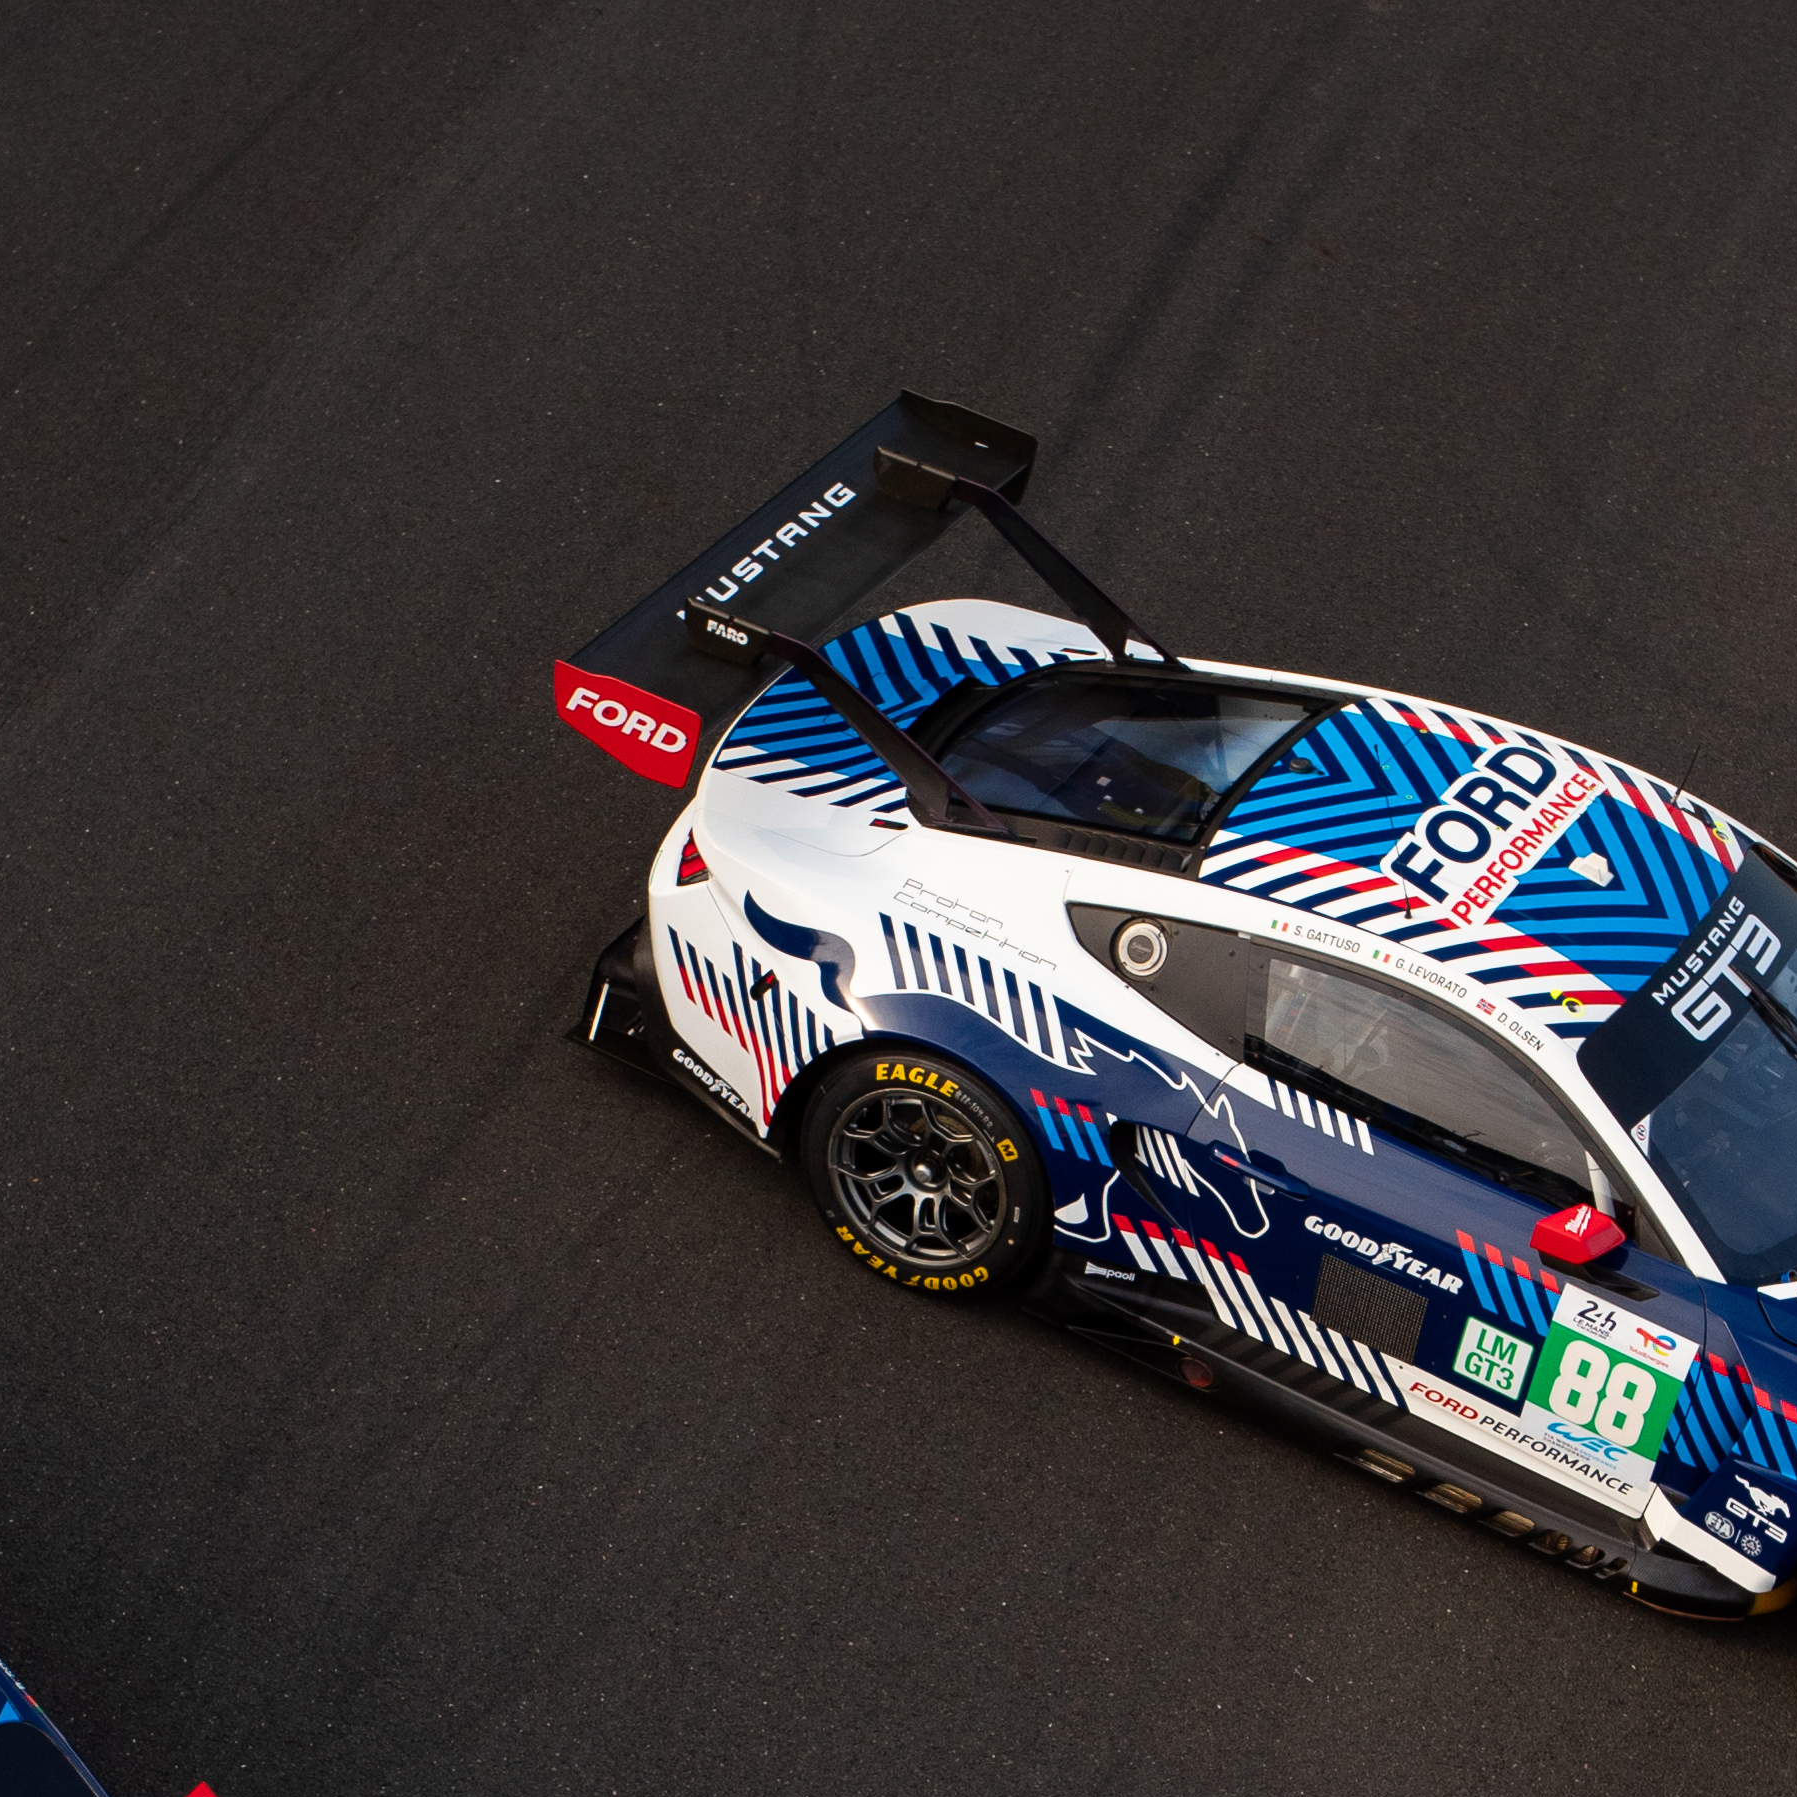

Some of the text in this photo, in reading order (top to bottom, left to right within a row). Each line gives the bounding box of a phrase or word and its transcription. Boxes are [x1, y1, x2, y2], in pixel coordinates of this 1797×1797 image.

[707, 620, 749, 645] FARO
[566, 687, 688, 754] FORD
[1401, 747, 1557, 902] FORD
[1452, 771, 1599, 925] PERFORMANCE
[903, 878, 1003, 931] Proton
[893, 891, 1057, 972] Competition
[1294, 924, 1361, 954] S. GATTUSO
[1651, 896, 1744, 1005] MUSTANG
[1395, 957, 1468, 998] G. LEVORATO
[1671, 913, 1781, 1042] GT3
[1496, 1010, 1546, 1053] D. OLSEN
[875, 1062, 960, 1098] EAGLE
[836, 1225, 989, 1290] GOODYEAR
[1105, 1268, 1135, 1283] paoli
[1304, 1215, 1463, 1295] GOODYEAR
[1577, 1301, 1617, 1332] 24h
[1476, 1328, 1518, 1366] LM
[1464, 1354, 1513, 1393] GT3
[1549, 1340, 1657, 1447] 88
[1409, 1382, 1634, 1495] FORD PERFORMANCE
[1547, 1422, 1628, 1462] WEC
[1726, 1497, 1787, 1544] GT3
